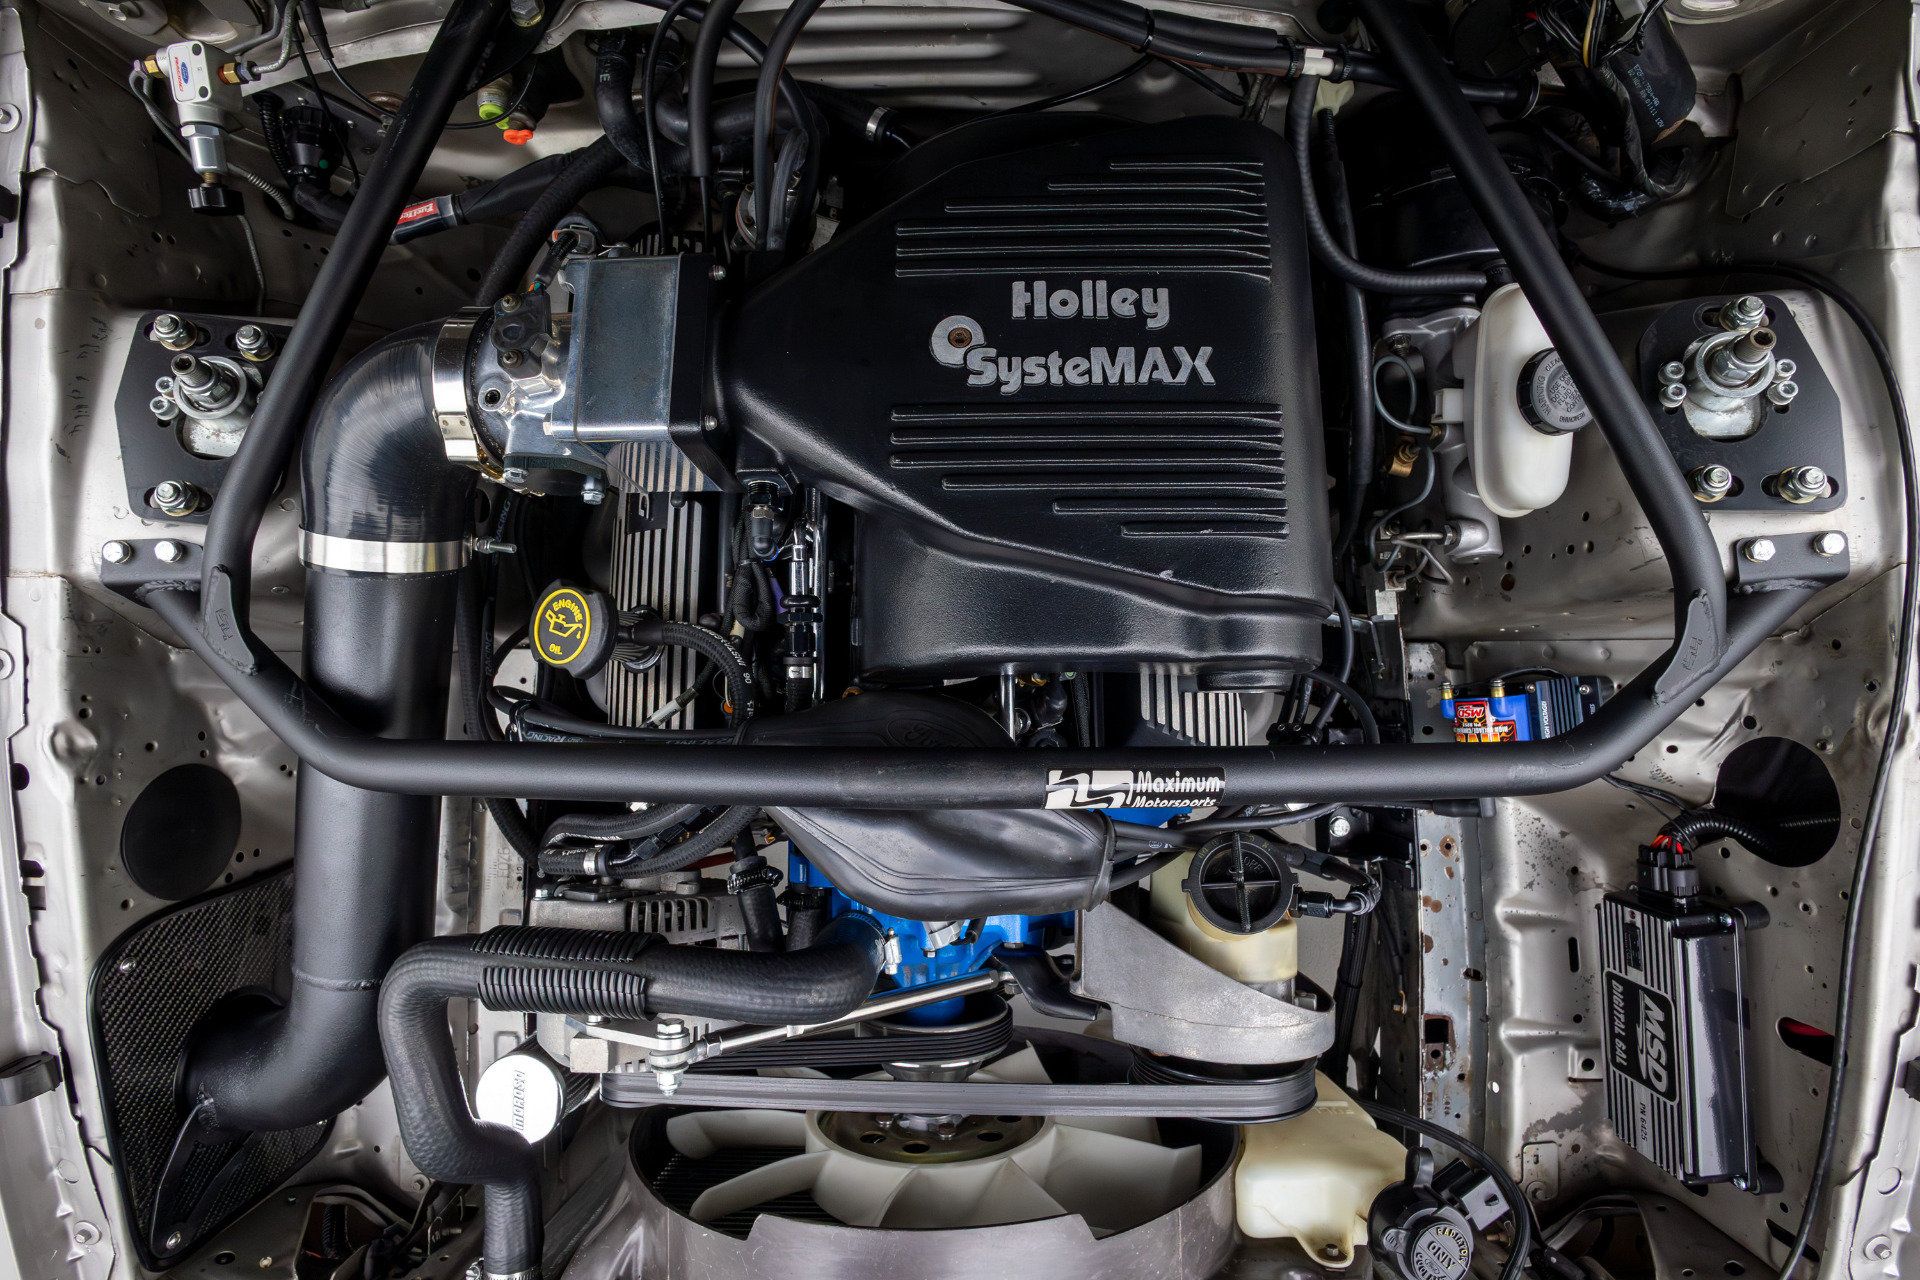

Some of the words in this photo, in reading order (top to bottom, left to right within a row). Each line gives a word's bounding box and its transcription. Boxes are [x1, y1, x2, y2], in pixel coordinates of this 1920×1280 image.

[1012, 280, 1169, 331] Holley
[966, 346, 1216, 395] SysteMAX
[1536, 375, 1552, 416] WARNING
[1549, 381, 1562, 394] USE
[1552, 390, 1563, 403] DOT
[1557, 389, 1572, 406] FLUID
[552, 598, 583, 623] ENGINE
[549, 642, 563, 656] OIL
[1457, 709, 1483, 718] MSD
[521, 731, 567, 743] RACING
[1135, 770, 1221, 793] Maximum
[1131, 795, 1216, 808] Motorsports
[1611, 979, 1626, 1035] DIGITAL
[1614, 1037, 1627, 1066] 6AL
[1641, 994, 1669, 1093] MSD
[1639, 1101, 1646, 1115] PN
[1640, 1116, 1648, 1142] 6425
[1427, 1240, 1457, 1270] ONLY
[1436, 1226, 1468, 1262] RADIATOR
